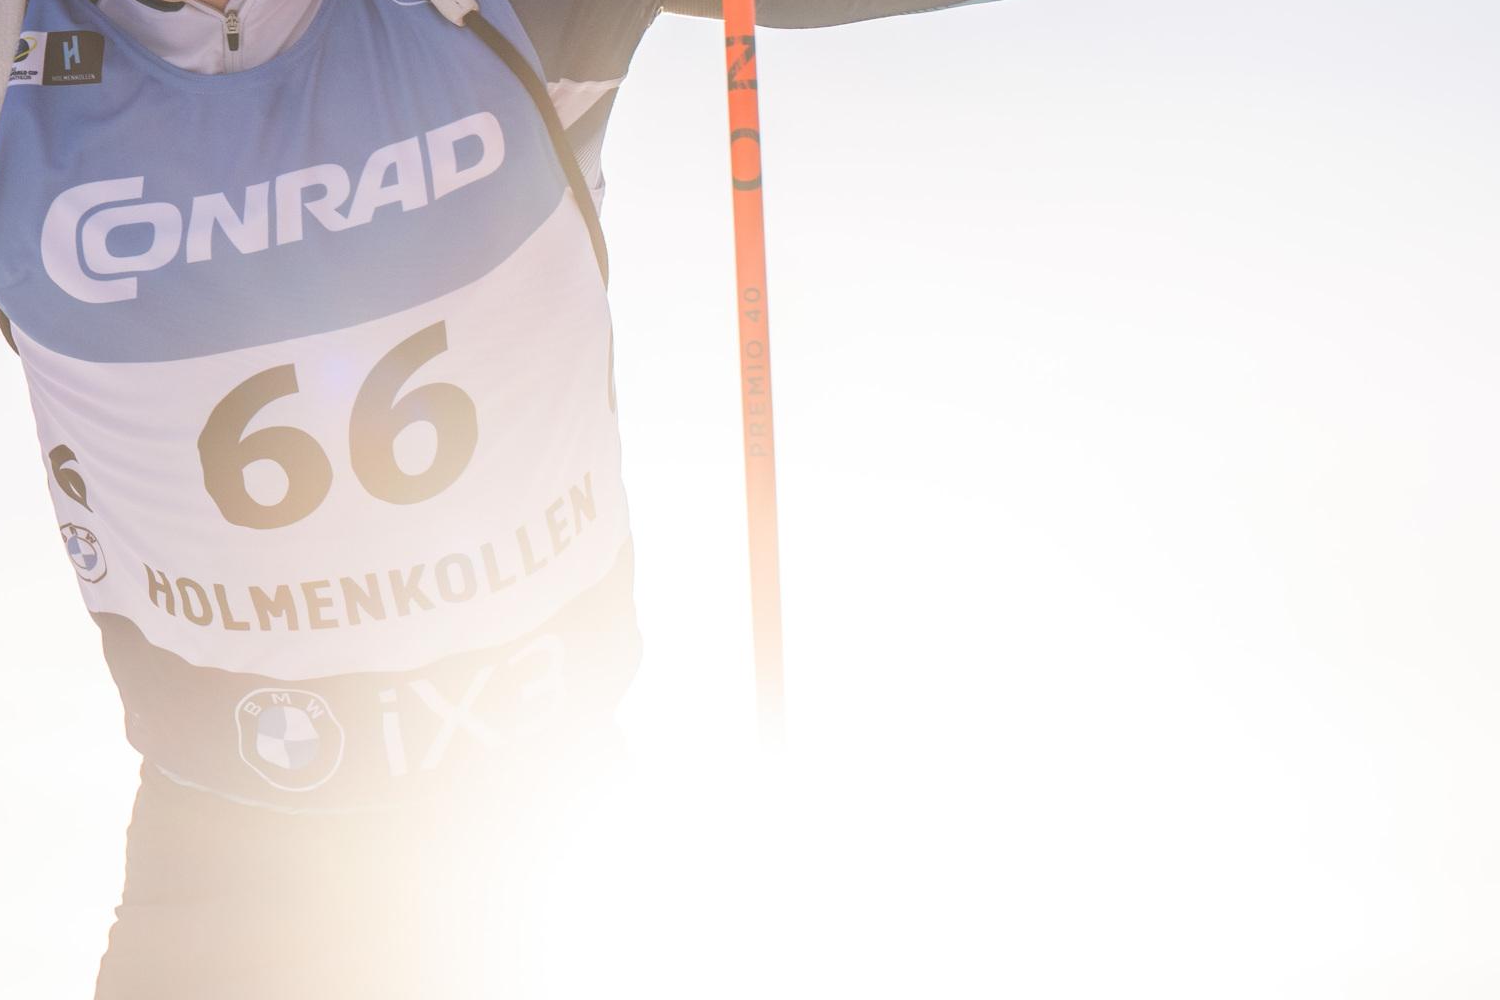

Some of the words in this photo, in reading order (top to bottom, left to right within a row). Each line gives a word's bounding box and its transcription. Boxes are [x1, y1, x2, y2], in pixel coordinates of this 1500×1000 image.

[40, 111, 506, 304] CONRAD
[196, 319, 479, 530] 66
[141, 470, 597, 632] HOLMENKOLLEN
[243, 692, 325, 719] BMW
